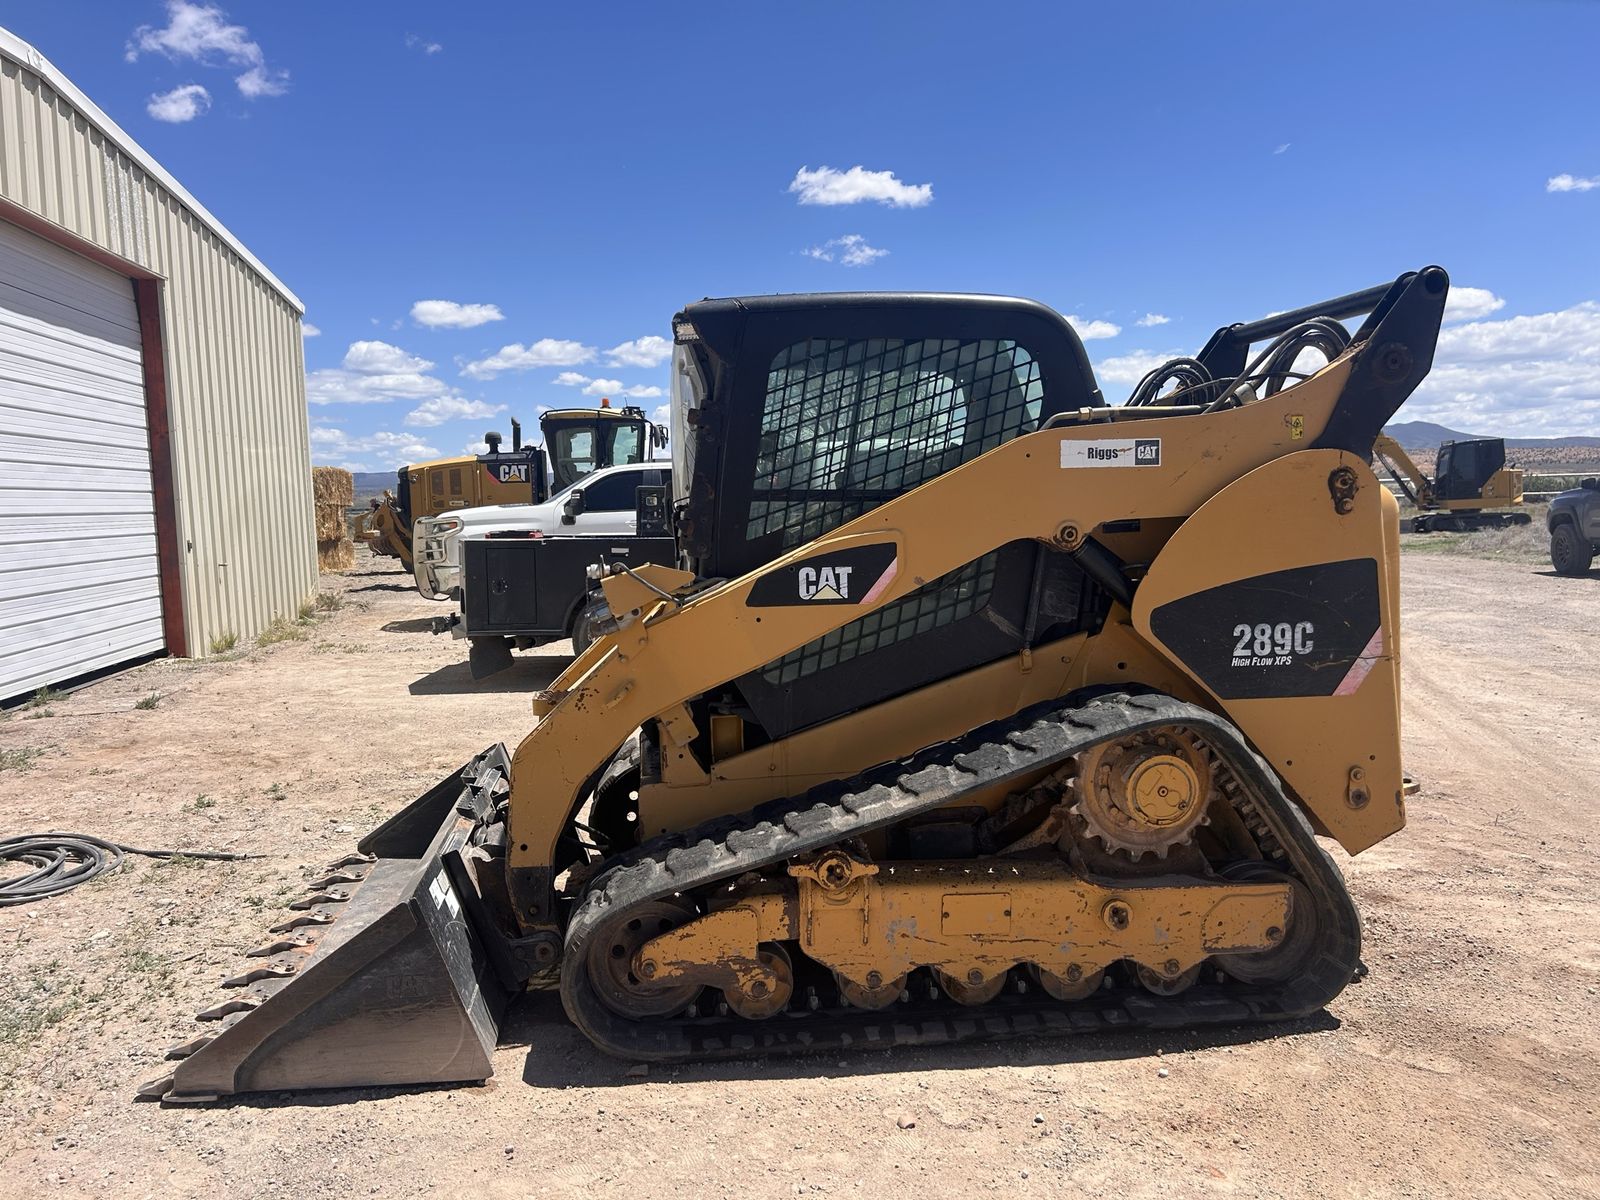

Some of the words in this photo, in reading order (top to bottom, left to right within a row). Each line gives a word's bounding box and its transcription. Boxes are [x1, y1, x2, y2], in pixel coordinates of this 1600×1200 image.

[1087, 447, 1119, 460] Riggs
[1137, 445, 1158, 459] CAT
[500, 464, 527, 482] CAT
[798, 566, 852, 600] CAT
[1232, 620, 1314, 656] 289C
[1274, 656, 1292, 666] XPS
